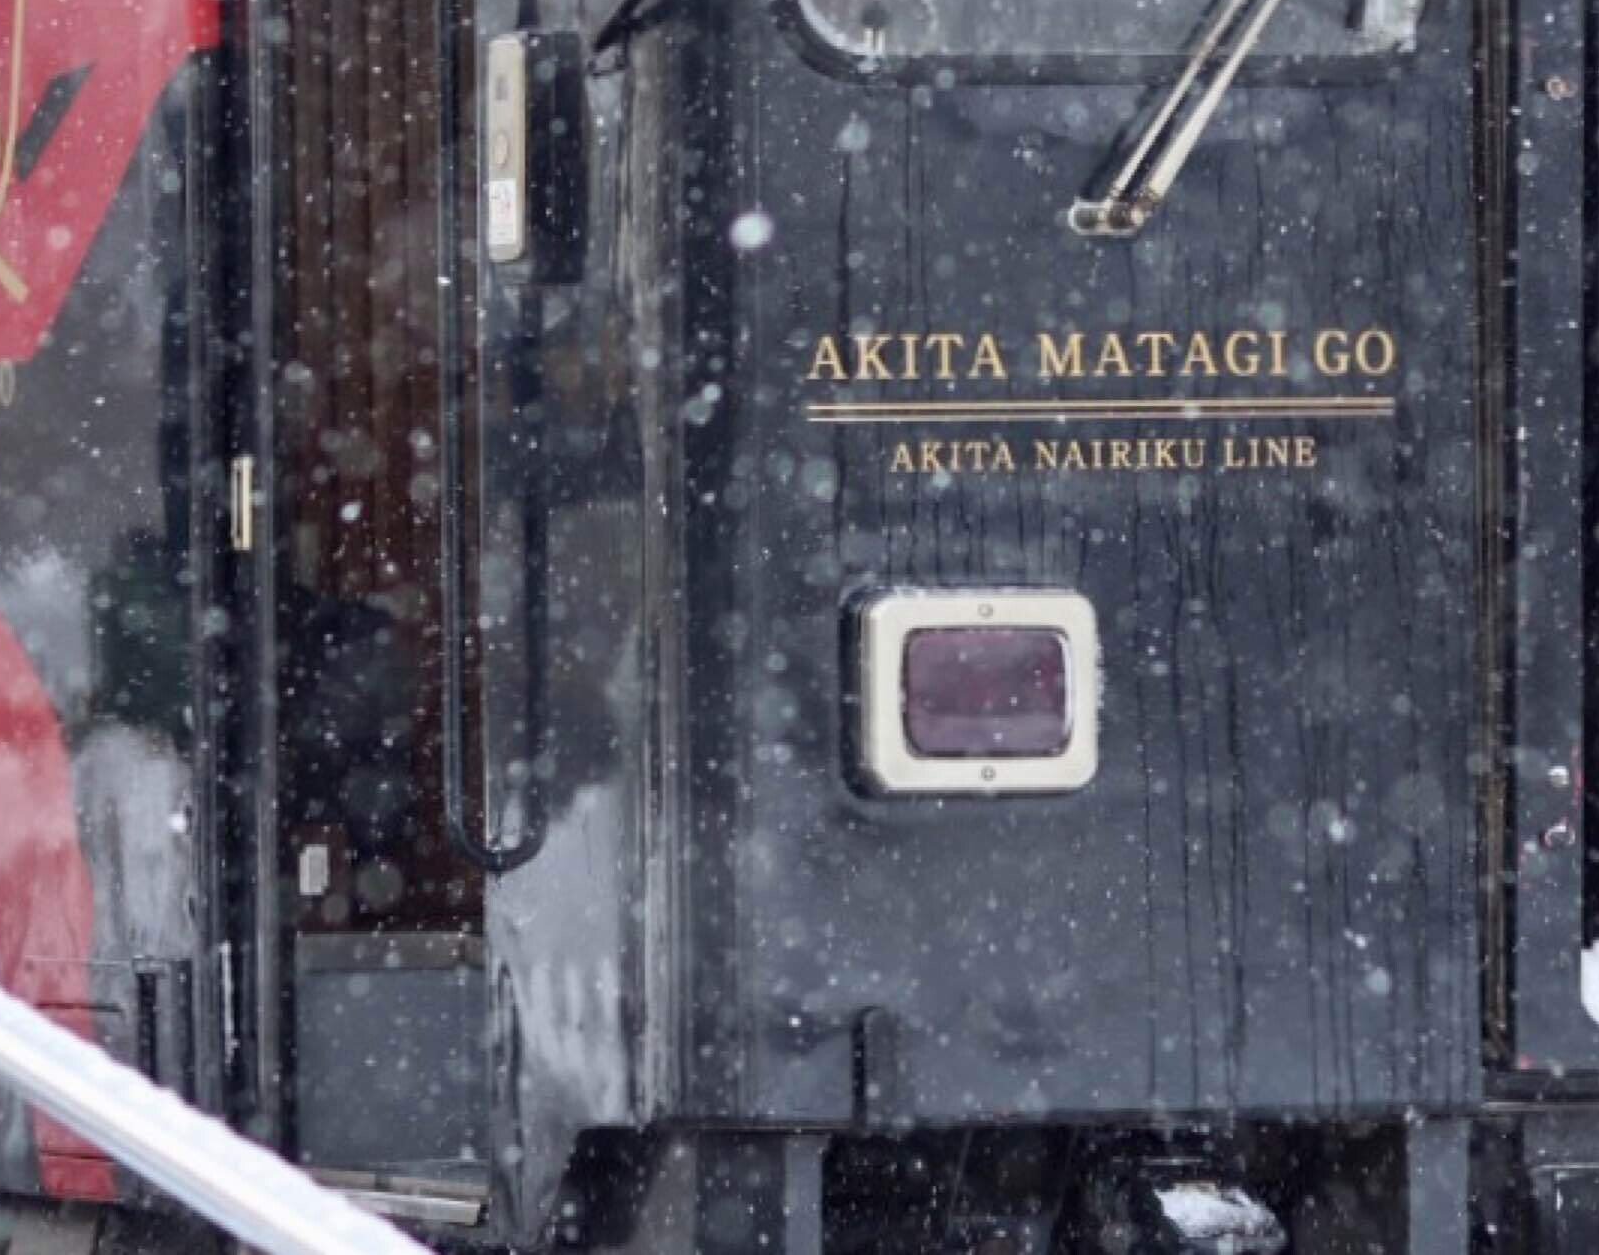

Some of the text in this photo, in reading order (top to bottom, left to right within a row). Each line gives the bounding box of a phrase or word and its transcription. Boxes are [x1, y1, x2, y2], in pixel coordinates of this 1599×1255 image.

[807, 329, 1397, 380] AKITA MATAGI GO
[889, 435, 1318, 474] AKITA NAIRIKU LINE
